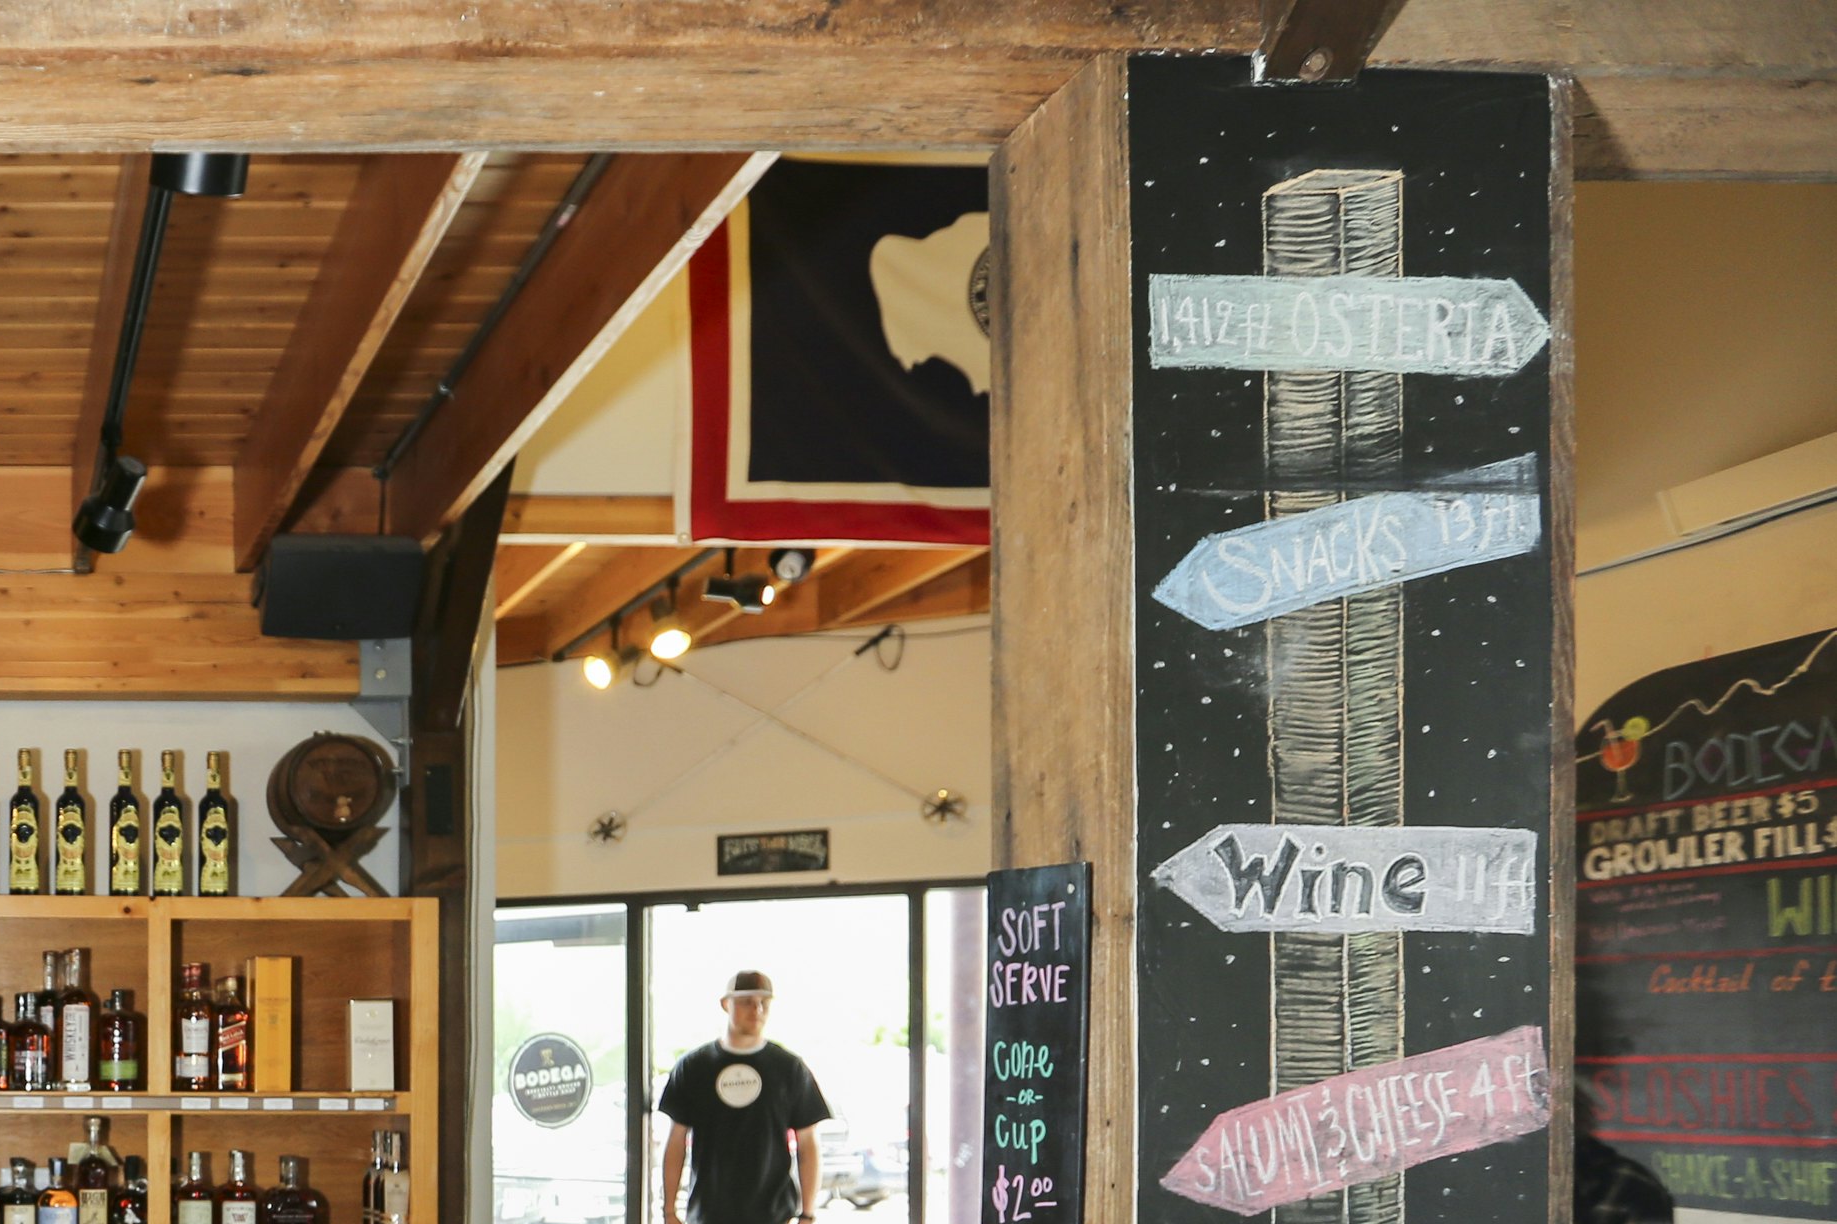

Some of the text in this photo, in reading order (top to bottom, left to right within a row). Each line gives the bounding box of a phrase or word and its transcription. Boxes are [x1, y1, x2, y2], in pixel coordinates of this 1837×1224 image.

[1160, 297, 1237, 353] 1,412
[1288, 291, 1517, 367] OSTERIA
[1200, 502, 1407, 614] SNACKS
[1589, 789, 1820, 845] DRAFT BEER $5
[1207, 831, 1430, 921] Wine
[1582, 830, 1748, 881] GROWLER
[1753, 822, 1825, 859] FILL
[997, 901, 1067, 957] SOFT
[989, 960, 1071, 1009] SERVE
[1769, 959, 1810, 992] of
[514, 1064, 587, 1090] BODEGA
[1590, 1066, 1814, 1131] SLOSHIES
[1346, 1069, 1464, 1163] CHEESE
[1469, 1059, 1497, 1119] 4
